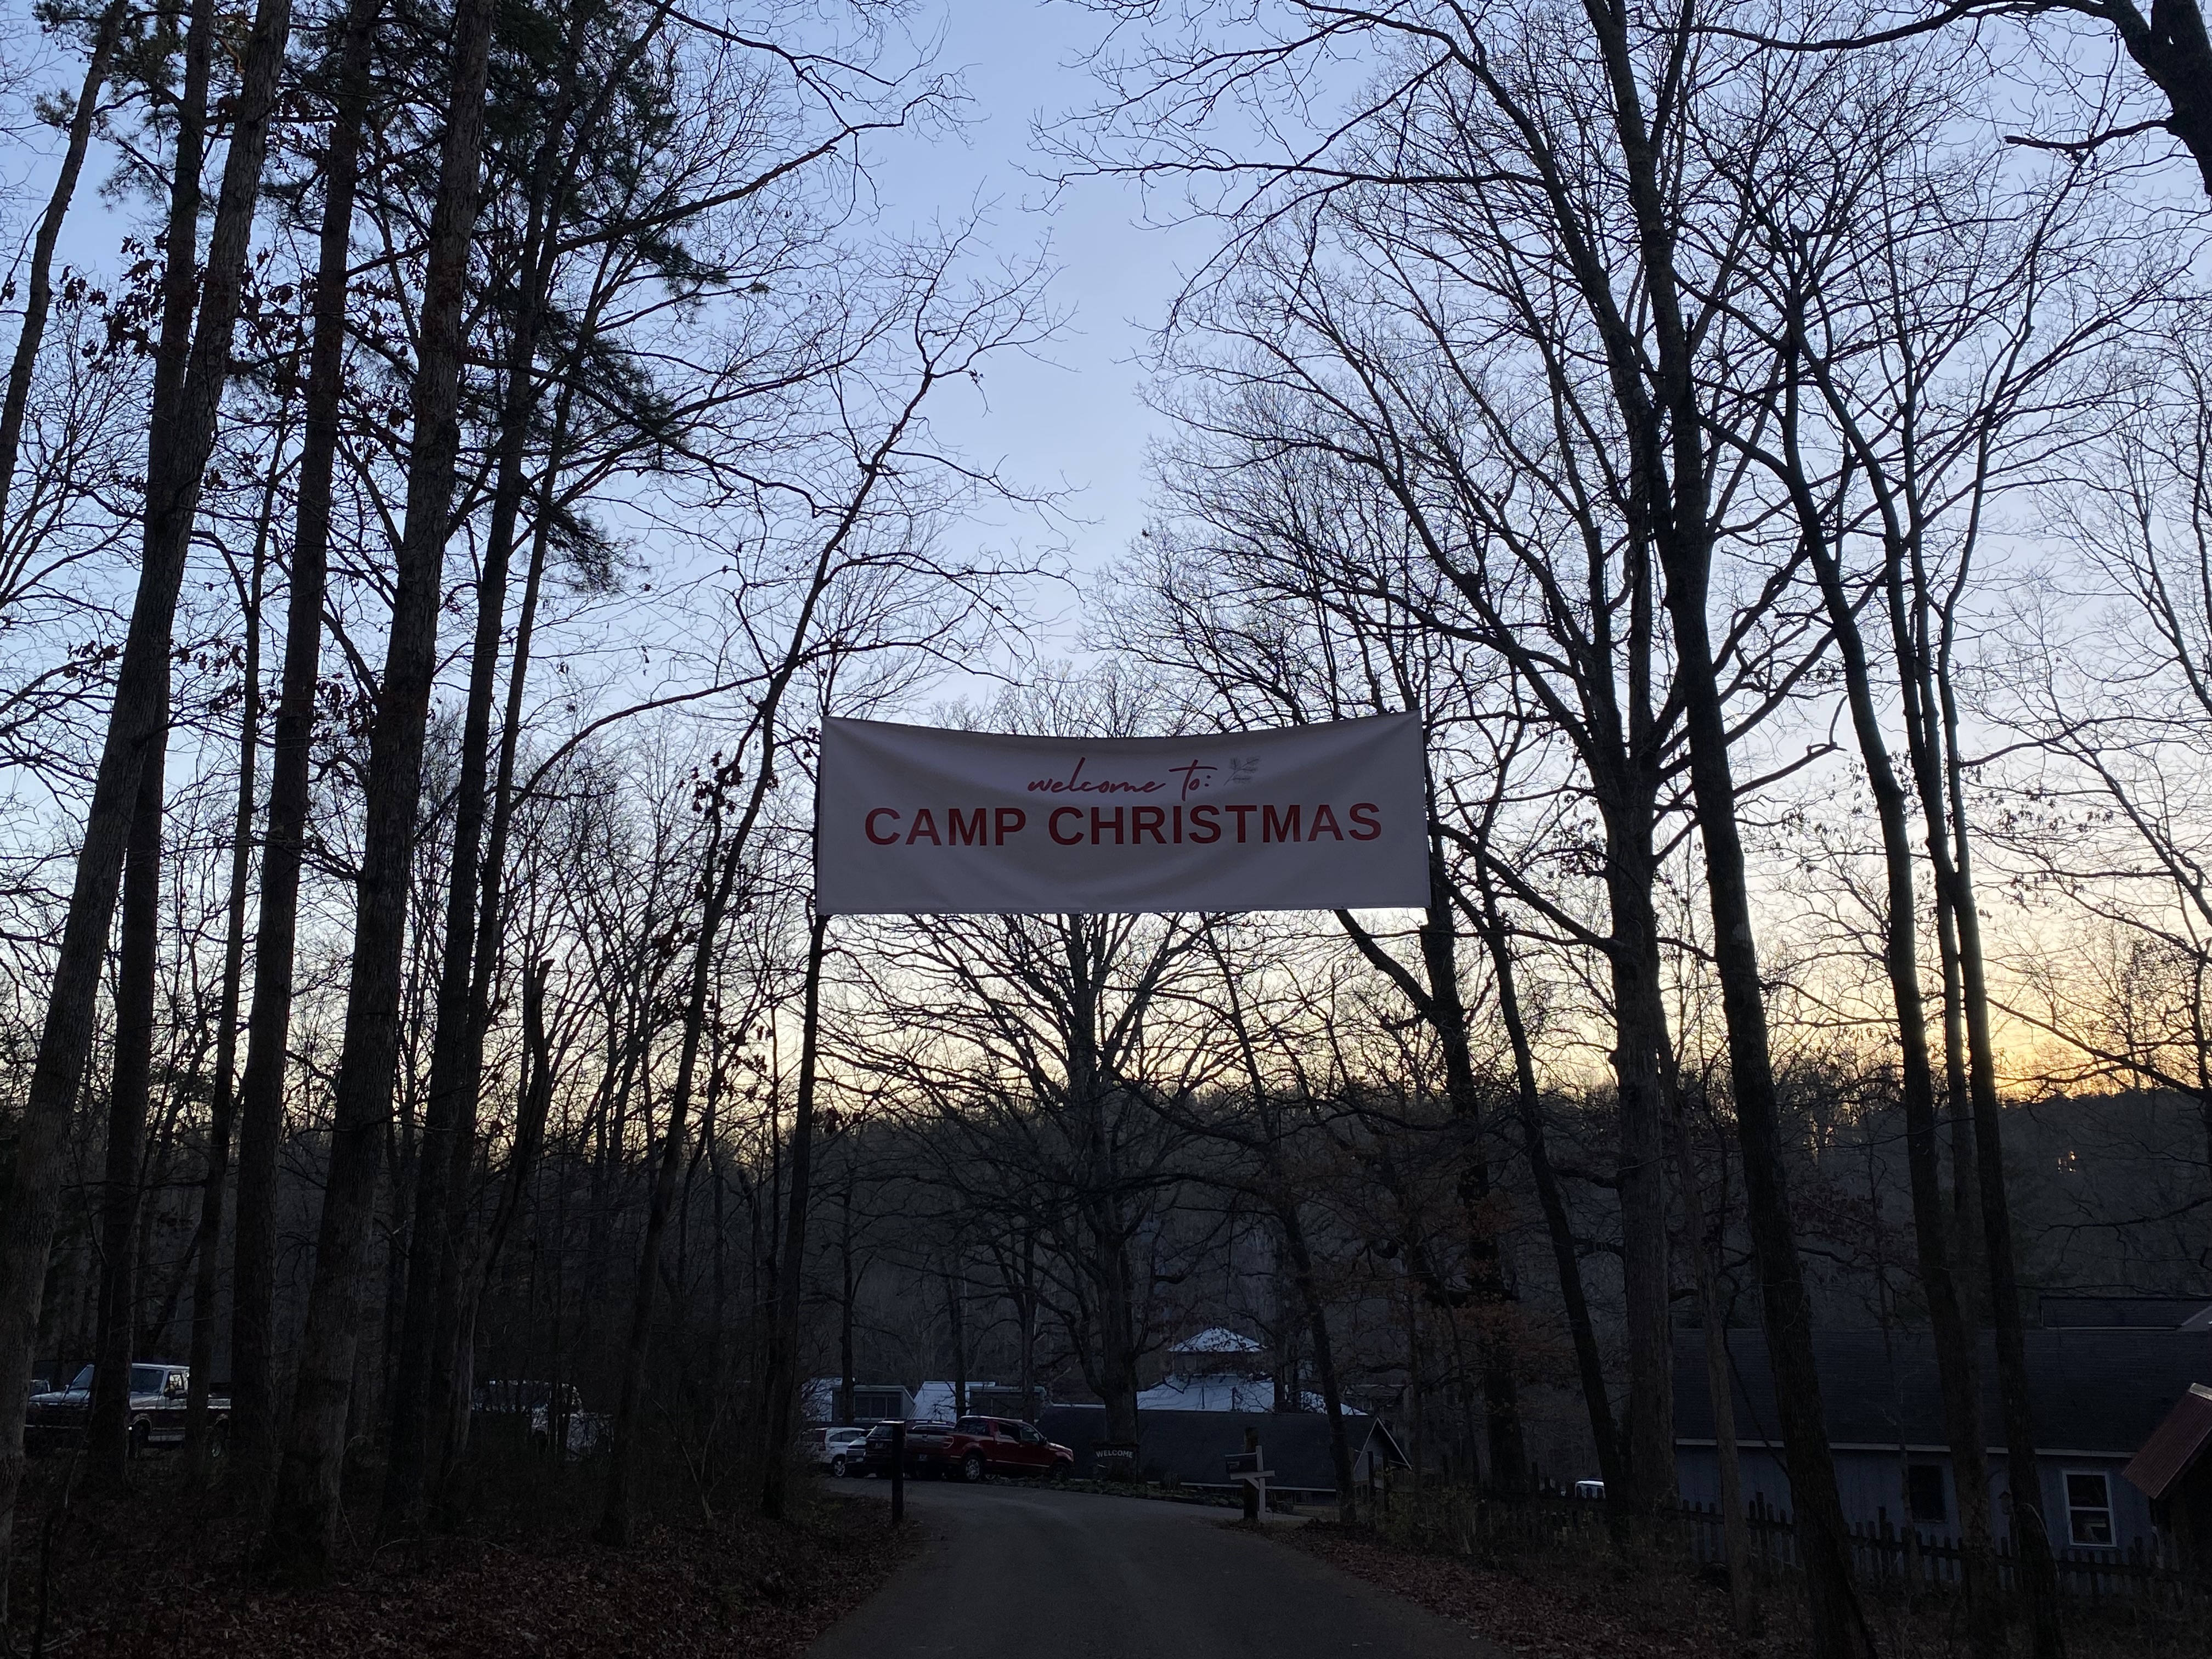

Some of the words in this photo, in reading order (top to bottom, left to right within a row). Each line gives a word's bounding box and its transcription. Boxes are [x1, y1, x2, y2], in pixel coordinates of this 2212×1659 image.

[1027, 757, 1166, 793] welcome
[1169, 759, 1218, 802] to:
[865, 807, 1026, 845] CAMP
[1048, 803, 1382, 845] CHRISTMAS
[1096, 1450, 1133, 1458] WELCOME
